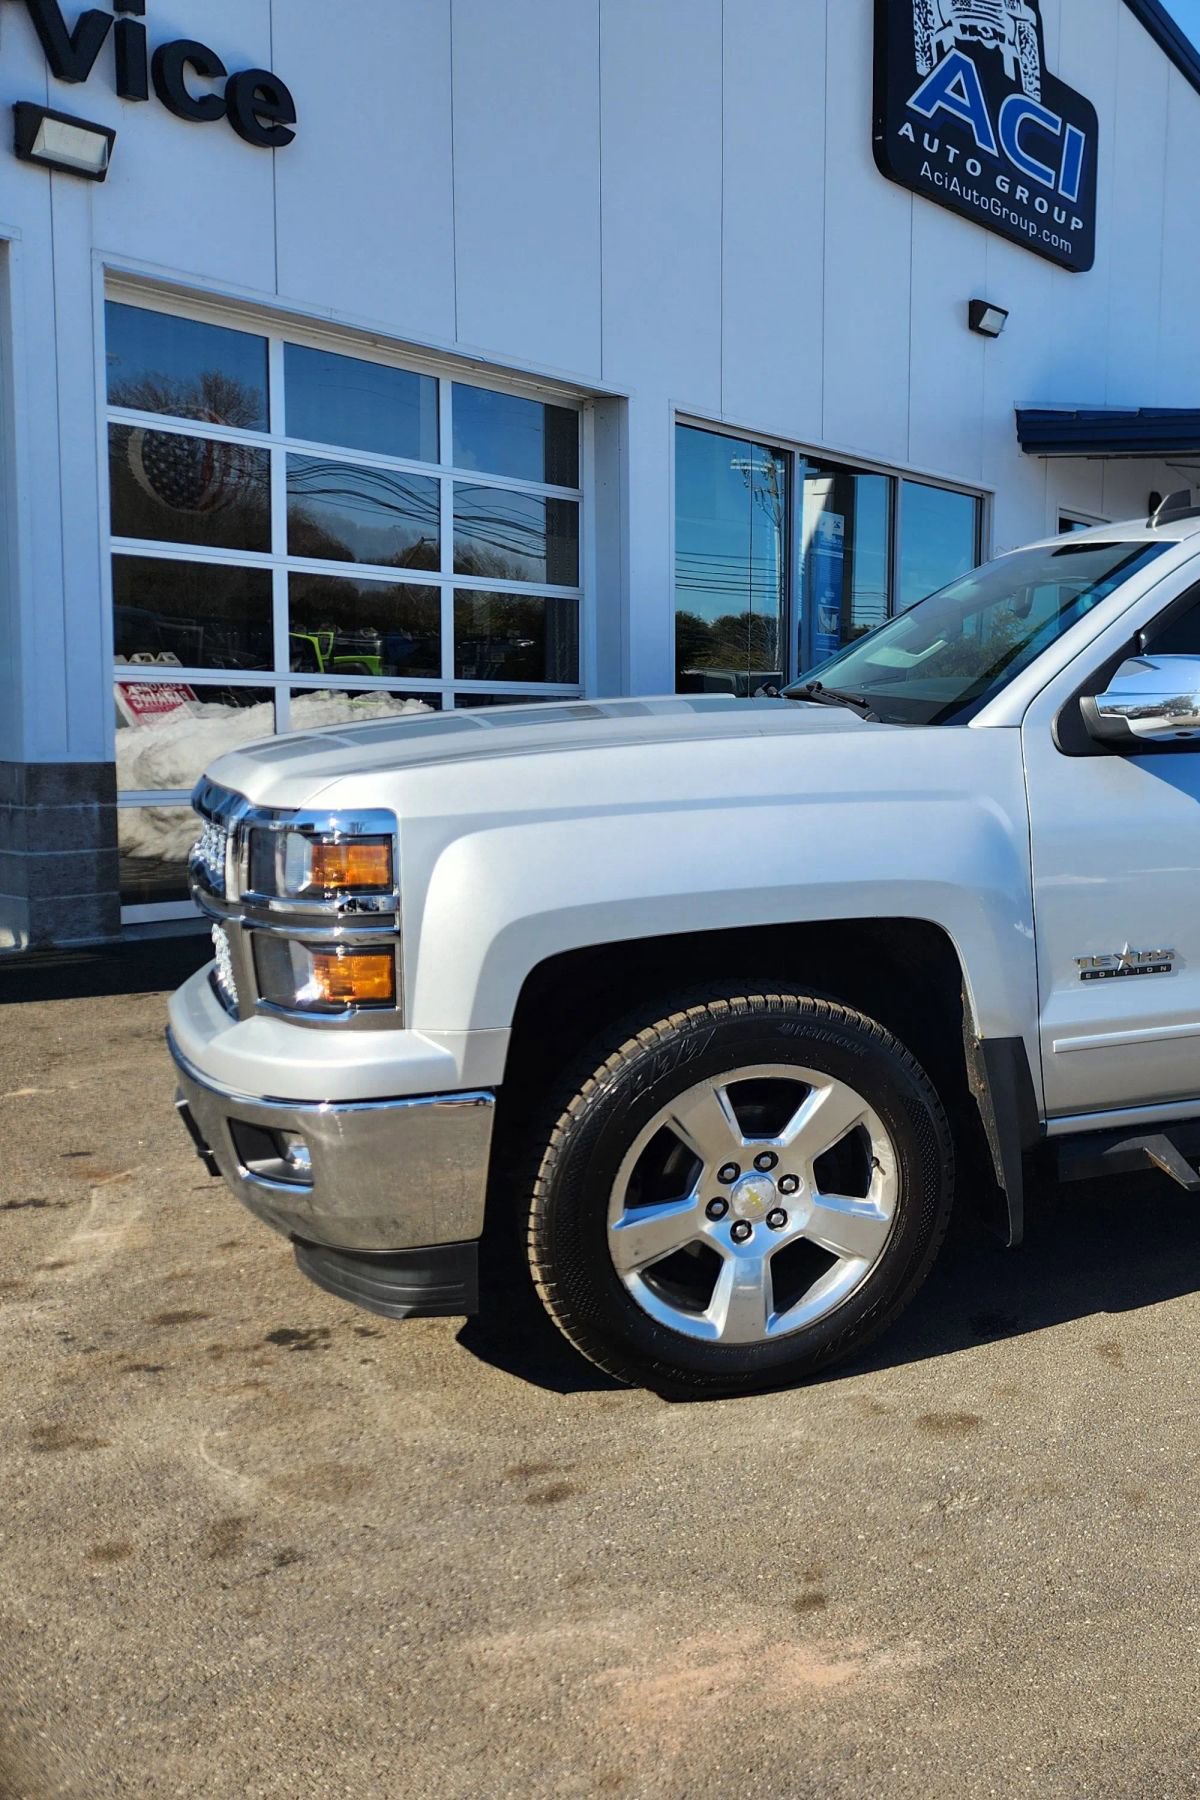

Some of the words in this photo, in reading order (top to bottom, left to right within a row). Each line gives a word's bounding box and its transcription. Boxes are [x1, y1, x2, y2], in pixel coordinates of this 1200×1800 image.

[905, 44, 1087, 204] ACI
[897, 121, 982, 177] AUTO
[995, 171, 1084, 231] GROUP
[920, 161, 1073, 254] AciAutoGroup.com
[1084, 964, 1168, 979] EDITION
